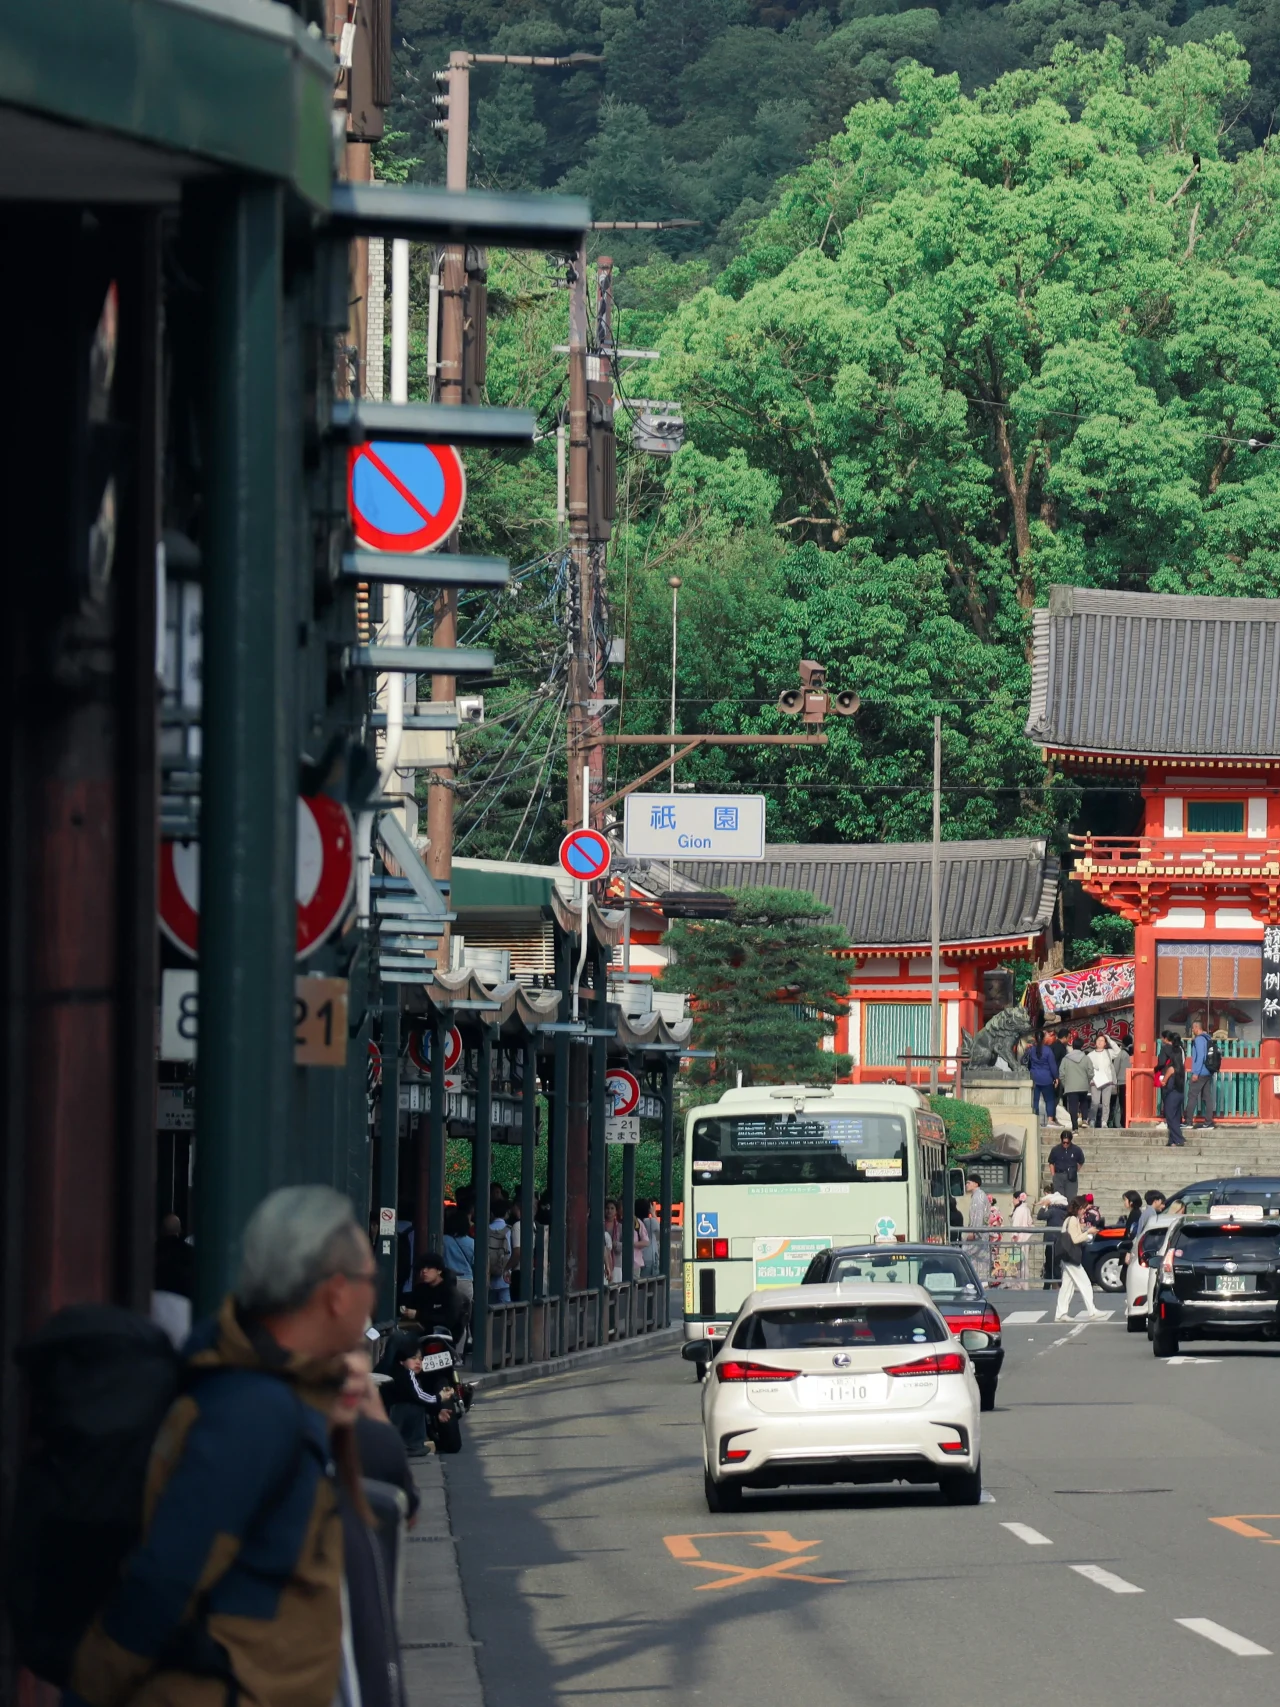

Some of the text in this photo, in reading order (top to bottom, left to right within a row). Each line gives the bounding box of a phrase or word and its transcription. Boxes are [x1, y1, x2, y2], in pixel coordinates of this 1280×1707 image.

[650, 805, 748, 831] 祇園
[678, 834, 711, 848] Gion
[1044, 974, 1102, 1005] いか焼
[1263, 972, 1280, 1017] 例祭
[424, 1357, 451, 1370] 29-82
